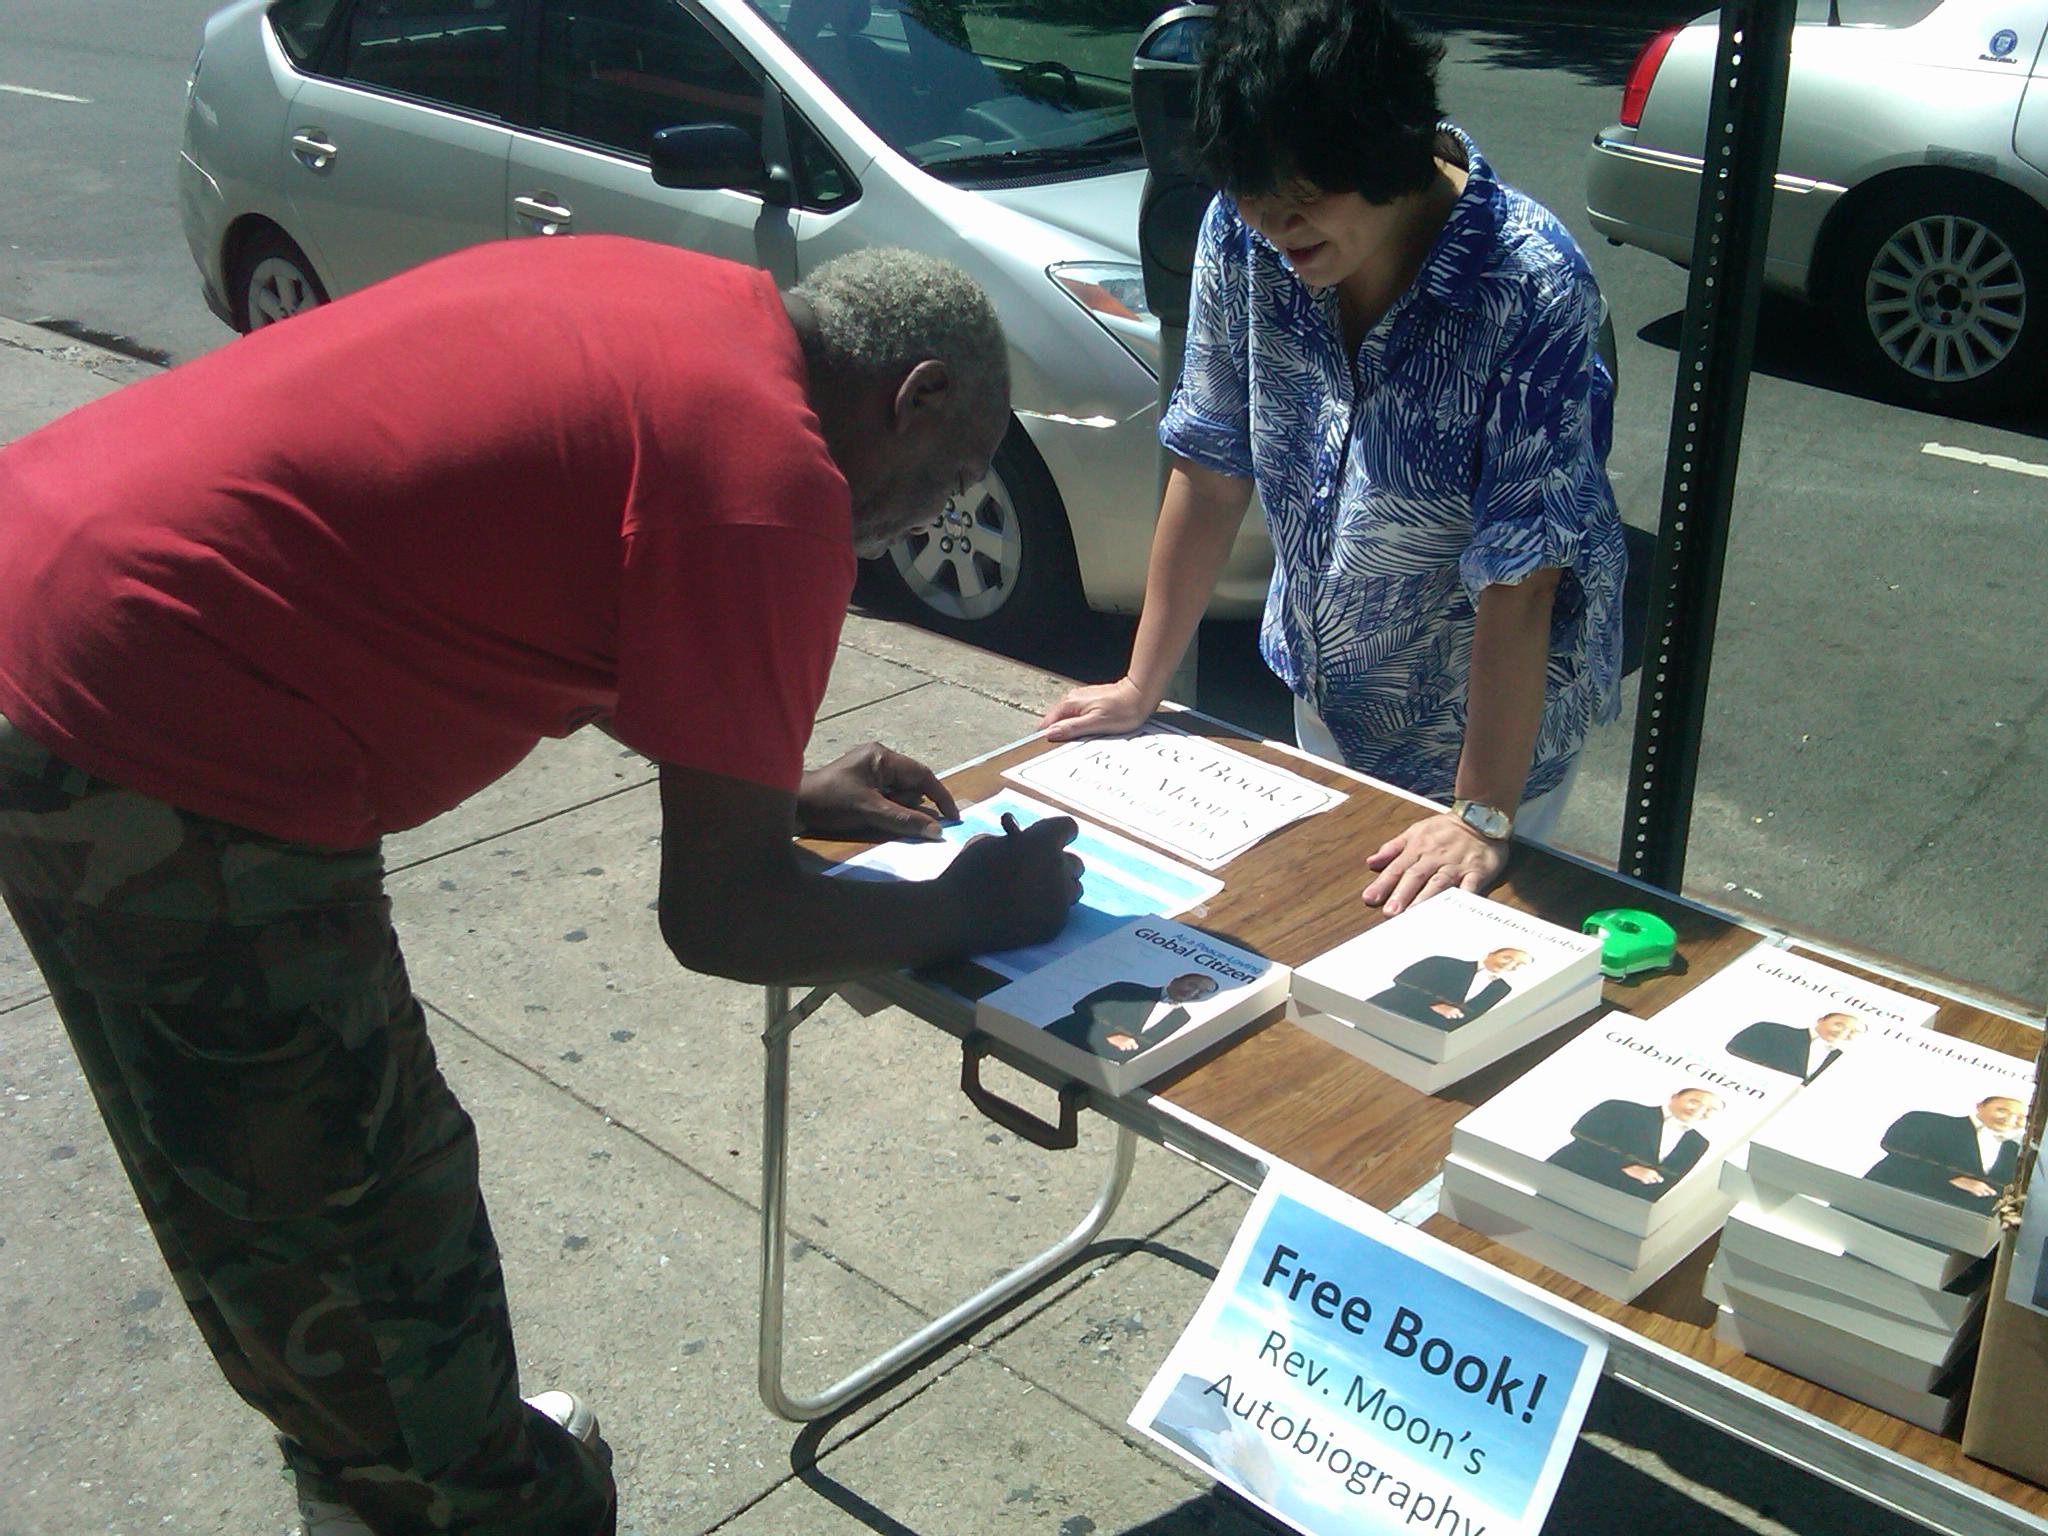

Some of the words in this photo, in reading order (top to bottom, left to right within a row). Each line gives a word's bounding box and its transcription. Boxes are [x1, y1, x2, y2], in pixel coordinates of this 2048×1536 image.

[1134, 928, 1198, 958] Global
[1193, 953, 1257, 984] Citizen
[1605, 1031, 1684, 1066] Global
[1684, 1062, 1767, 1100] Citizen
[1262, 1244, 1372, 1335] Free
[1383, 1307, 1548, 1424] Book!
[1258, 1330, 1330, 1396] Rev.
[1343, 1375, 1487, 1476] Moon's
